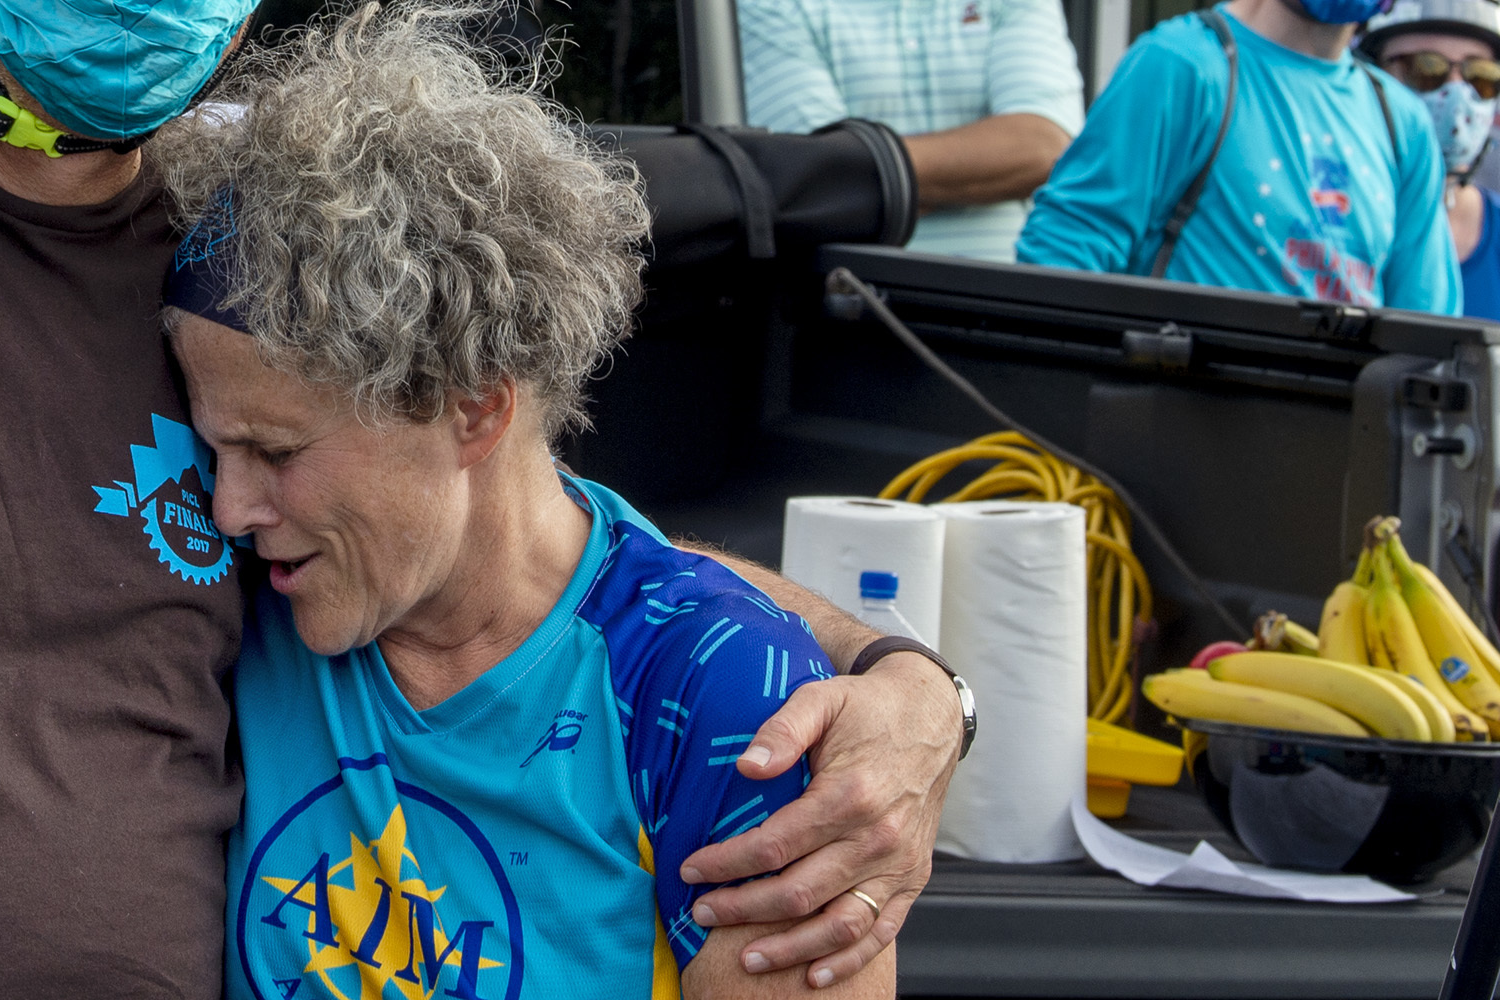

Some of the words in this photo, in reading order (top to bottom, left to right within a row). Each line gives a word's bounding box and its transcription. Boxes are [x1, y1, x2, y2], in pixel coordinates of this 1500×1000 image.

[163, 501, 220, 540] FINALS
[186, 536, 210, 554] 2017
[509, 852, 528, 866] TM
[261, 852, 494, 1000] AIM
